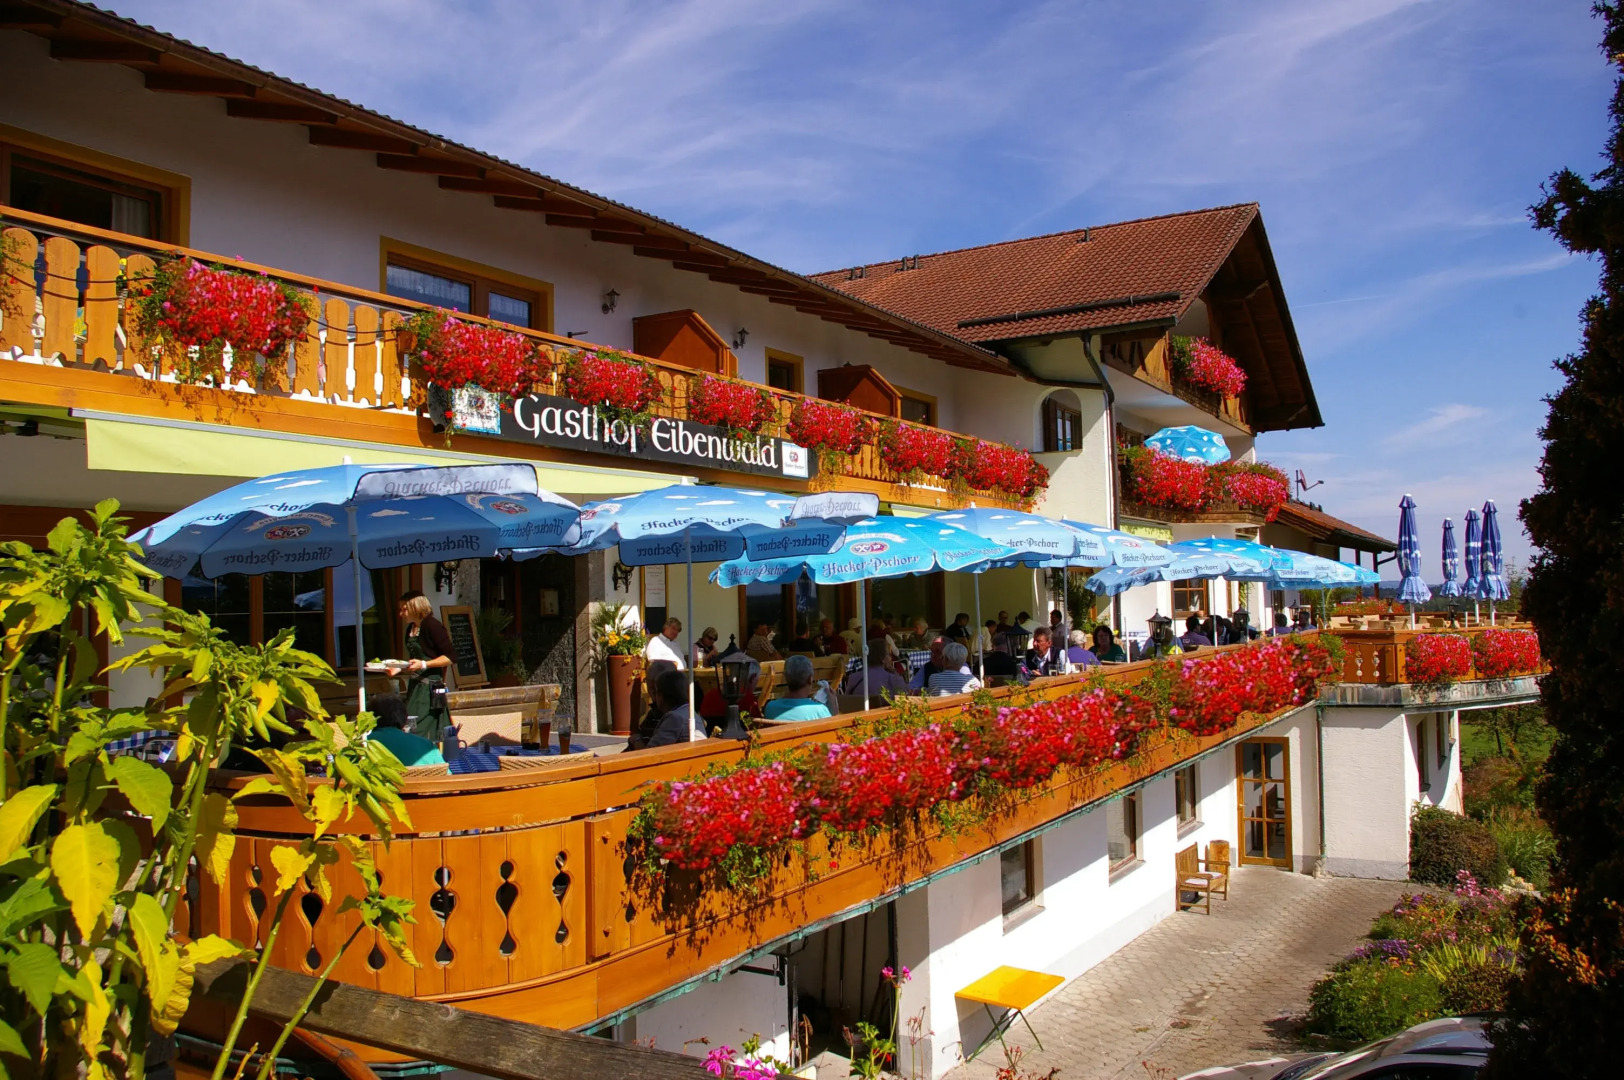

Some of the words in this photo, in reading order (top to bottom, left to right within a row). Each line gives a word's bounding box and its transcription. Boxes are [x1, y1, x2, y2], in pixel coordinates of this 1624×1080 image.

[514, 394, 645, 453] Gasthof
[651, 418, 778, 468] Eibenwald
[1006, 537, 1059, 548] ker-Pschorr
[822, 555, 921, 578] Hacker-Pschorr
